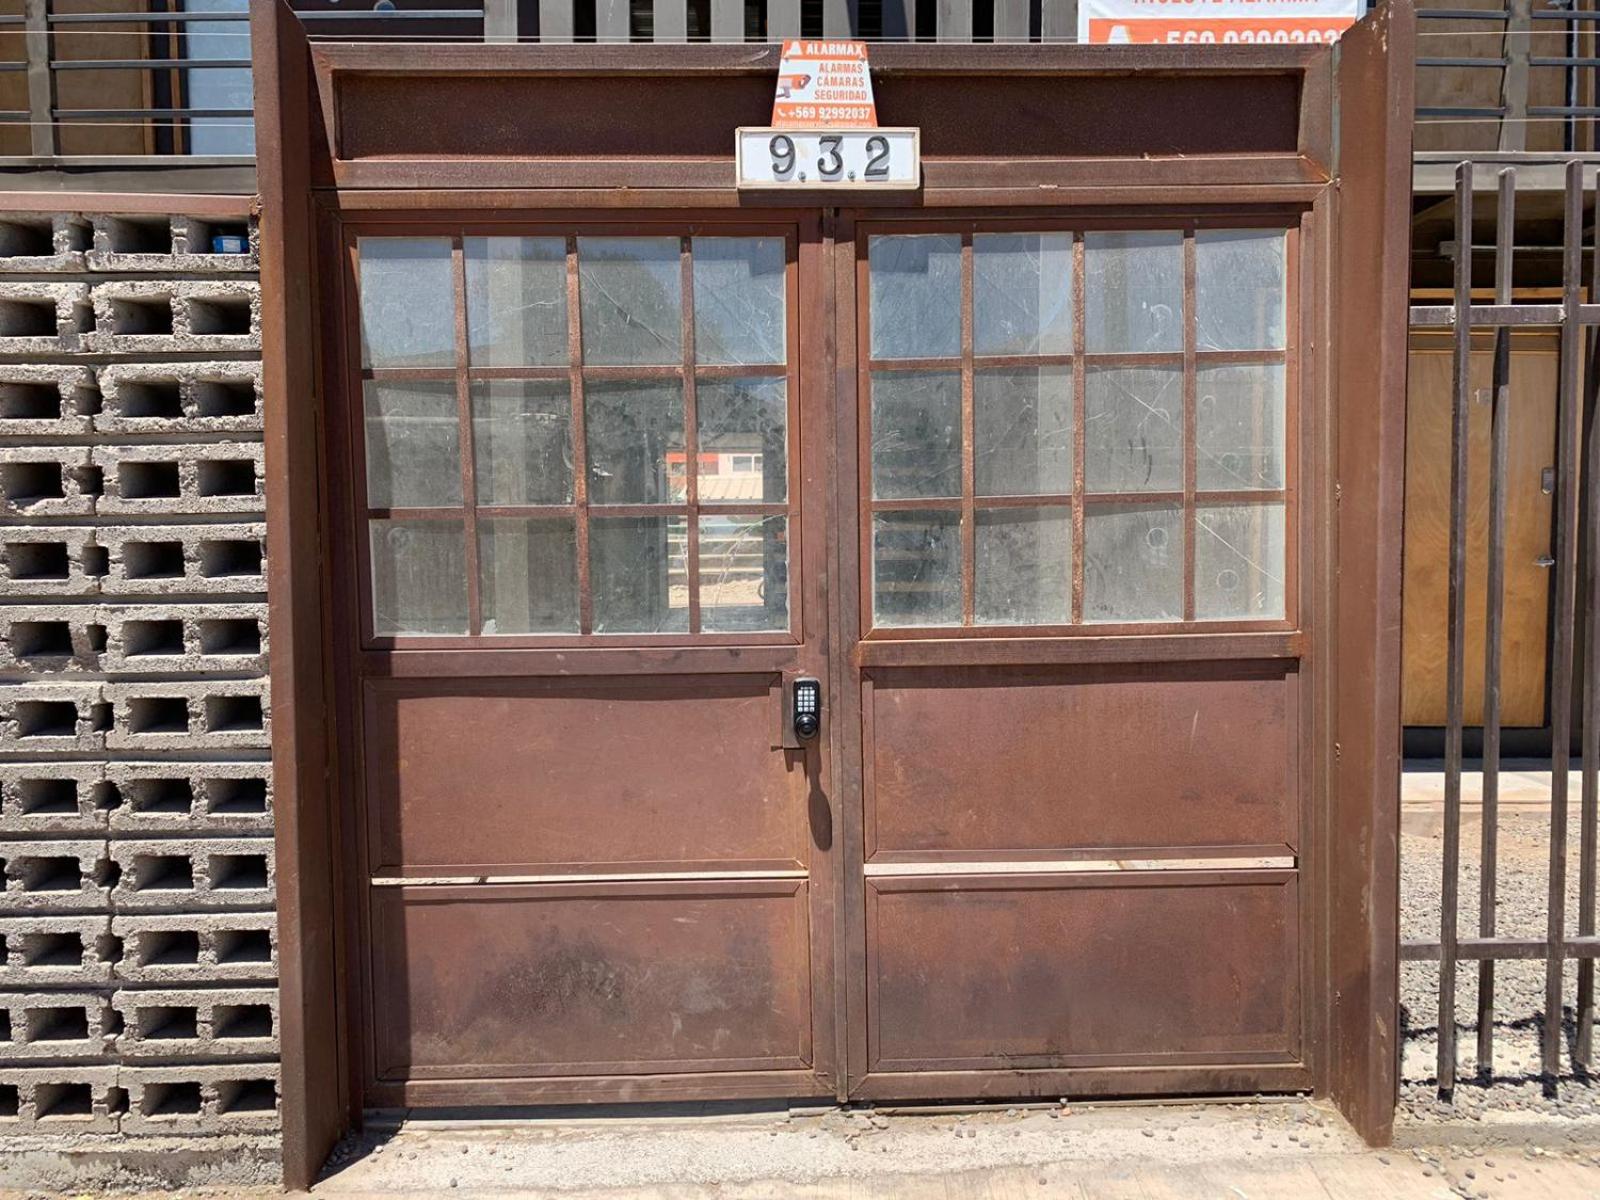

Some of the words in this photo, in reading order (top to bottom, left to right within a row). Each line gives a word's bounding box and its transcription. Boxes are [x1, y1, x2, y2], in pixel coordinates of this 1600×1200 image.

[806, 44, 862, 56] ALARMAX
[818, 63, 863, 74] ALARMAS
[814, 90, 867, 101] SEGURIDAD
[788, 107, 816, 119] +569
